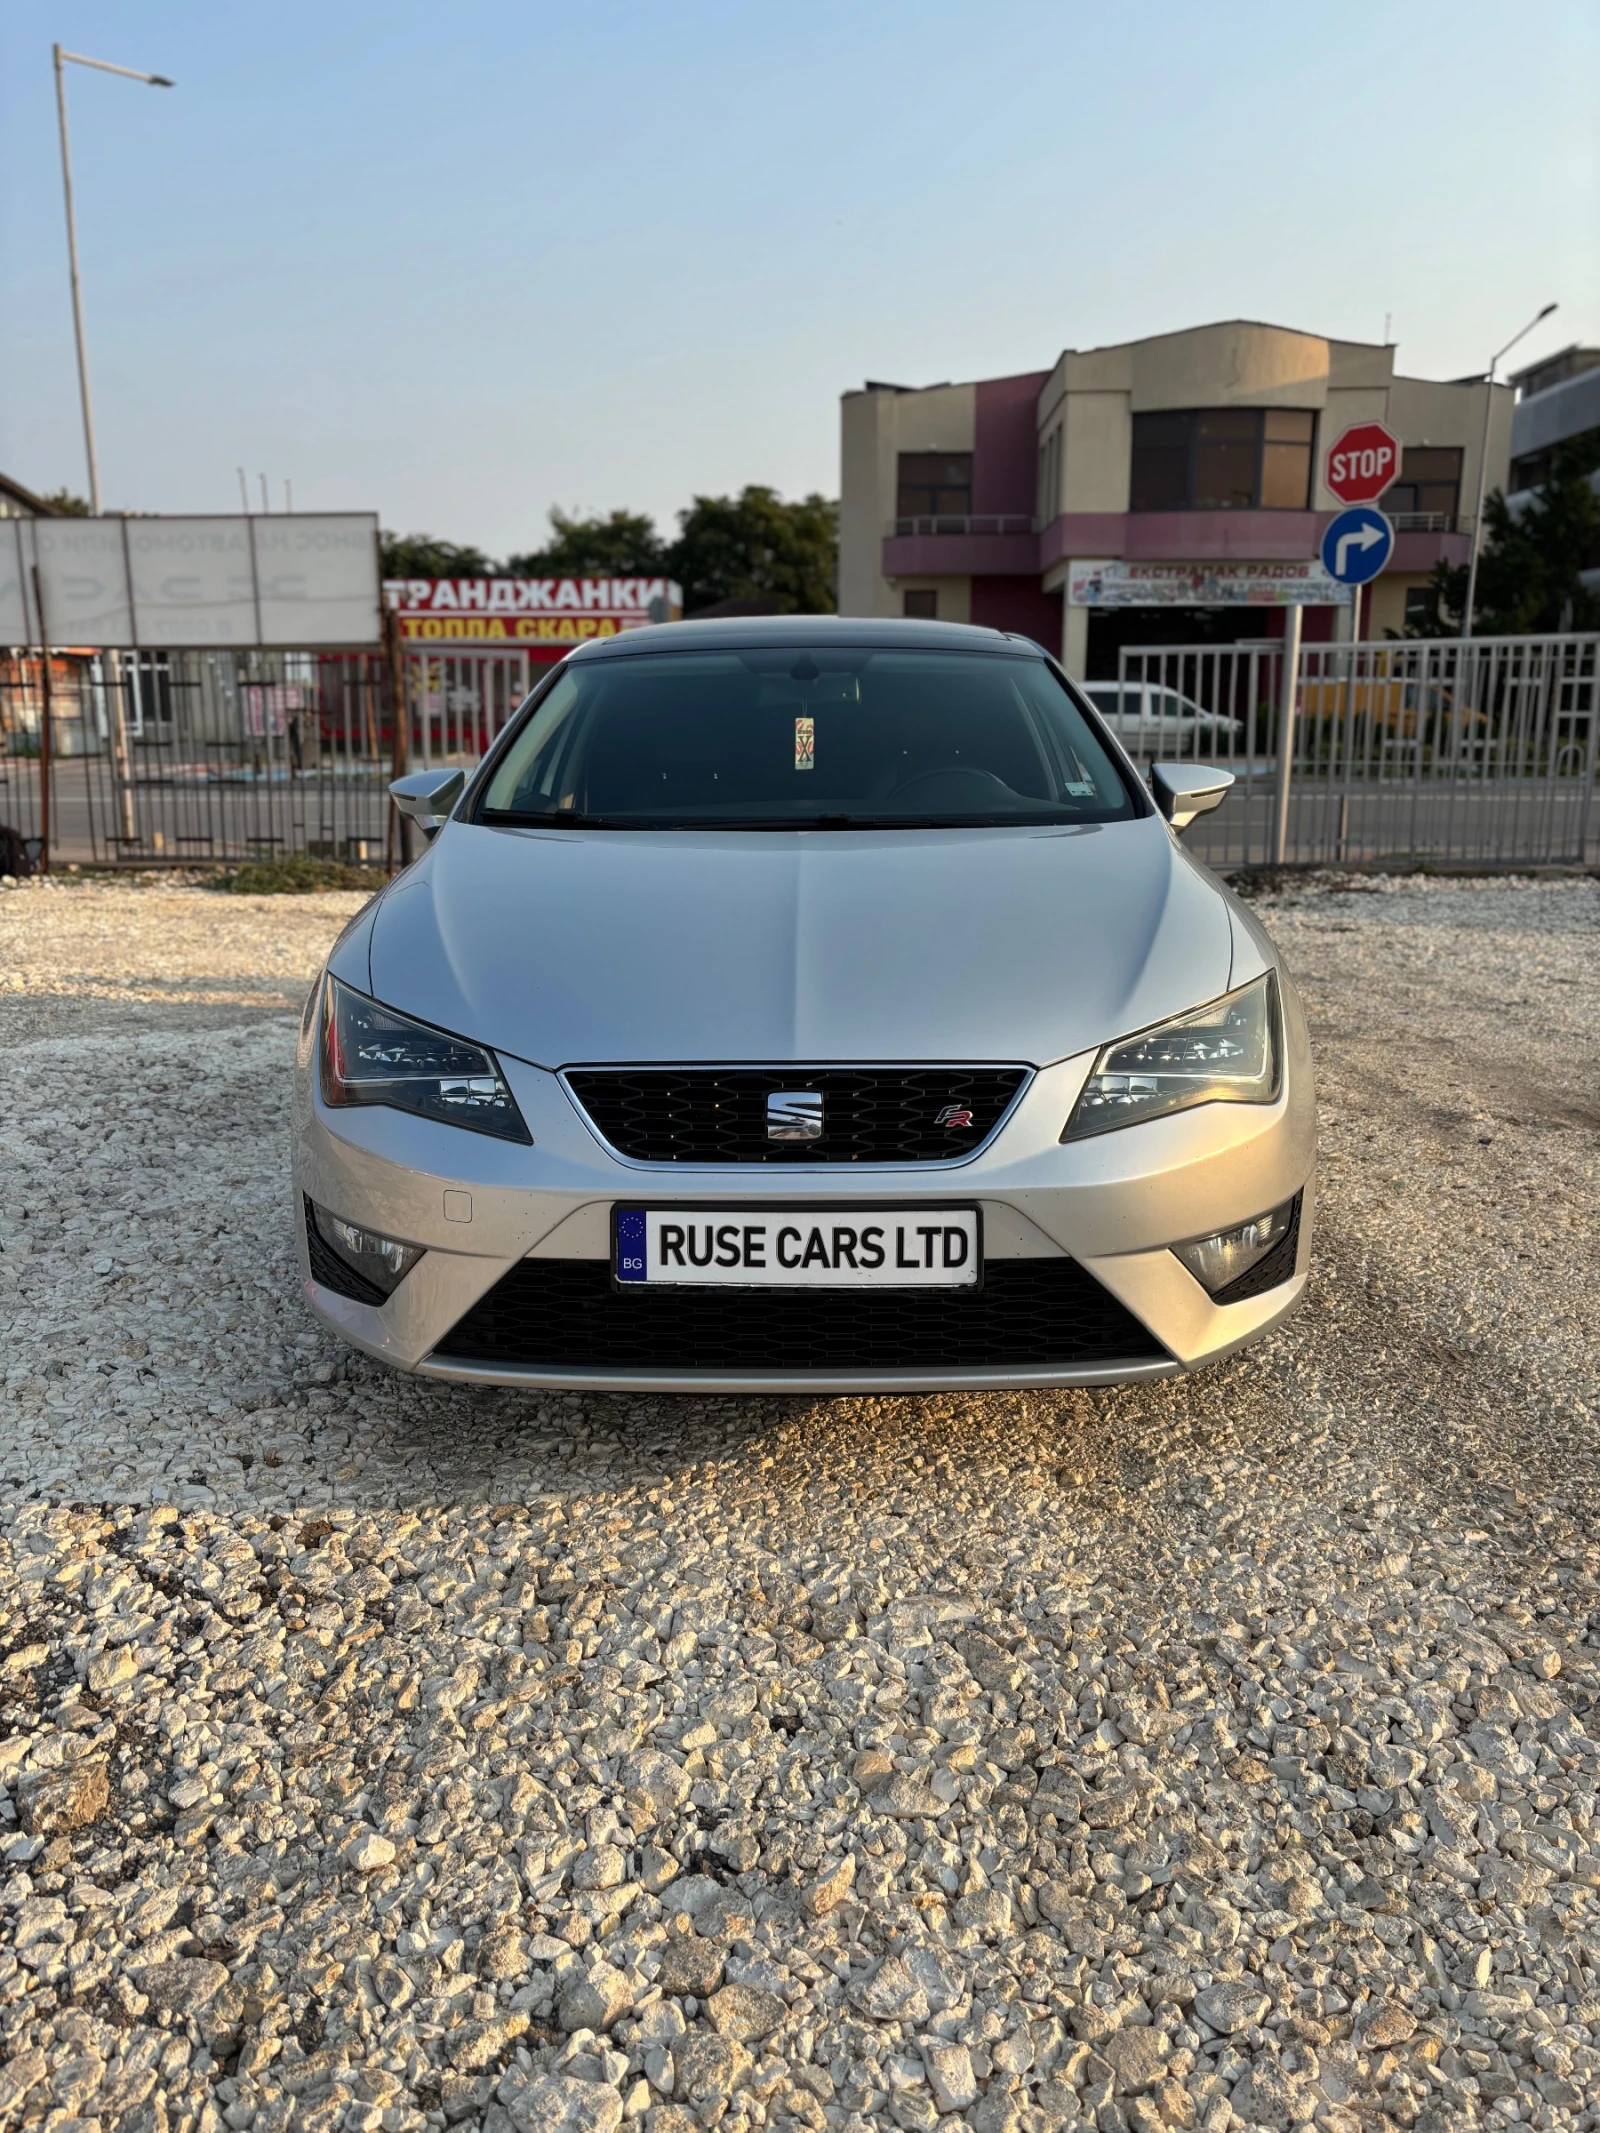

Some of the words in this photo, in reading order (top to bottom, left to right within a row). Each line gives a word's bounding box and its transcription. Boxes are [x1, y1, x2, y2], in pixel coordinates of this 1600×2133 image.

[1331, 447, 1392, 482] STOP
[403, 619, 507, 639] ТОПЛА
[515, 619, 617, 639] СКАРА
[934, 1104, 973, 1127] FR
[659, 1224, 767, 1268] RUSE
[775, 1225, 886, 1269] CARS
[896, 1226, 969, 1269] LTD
[623, 1257, 643, 1270] BG
